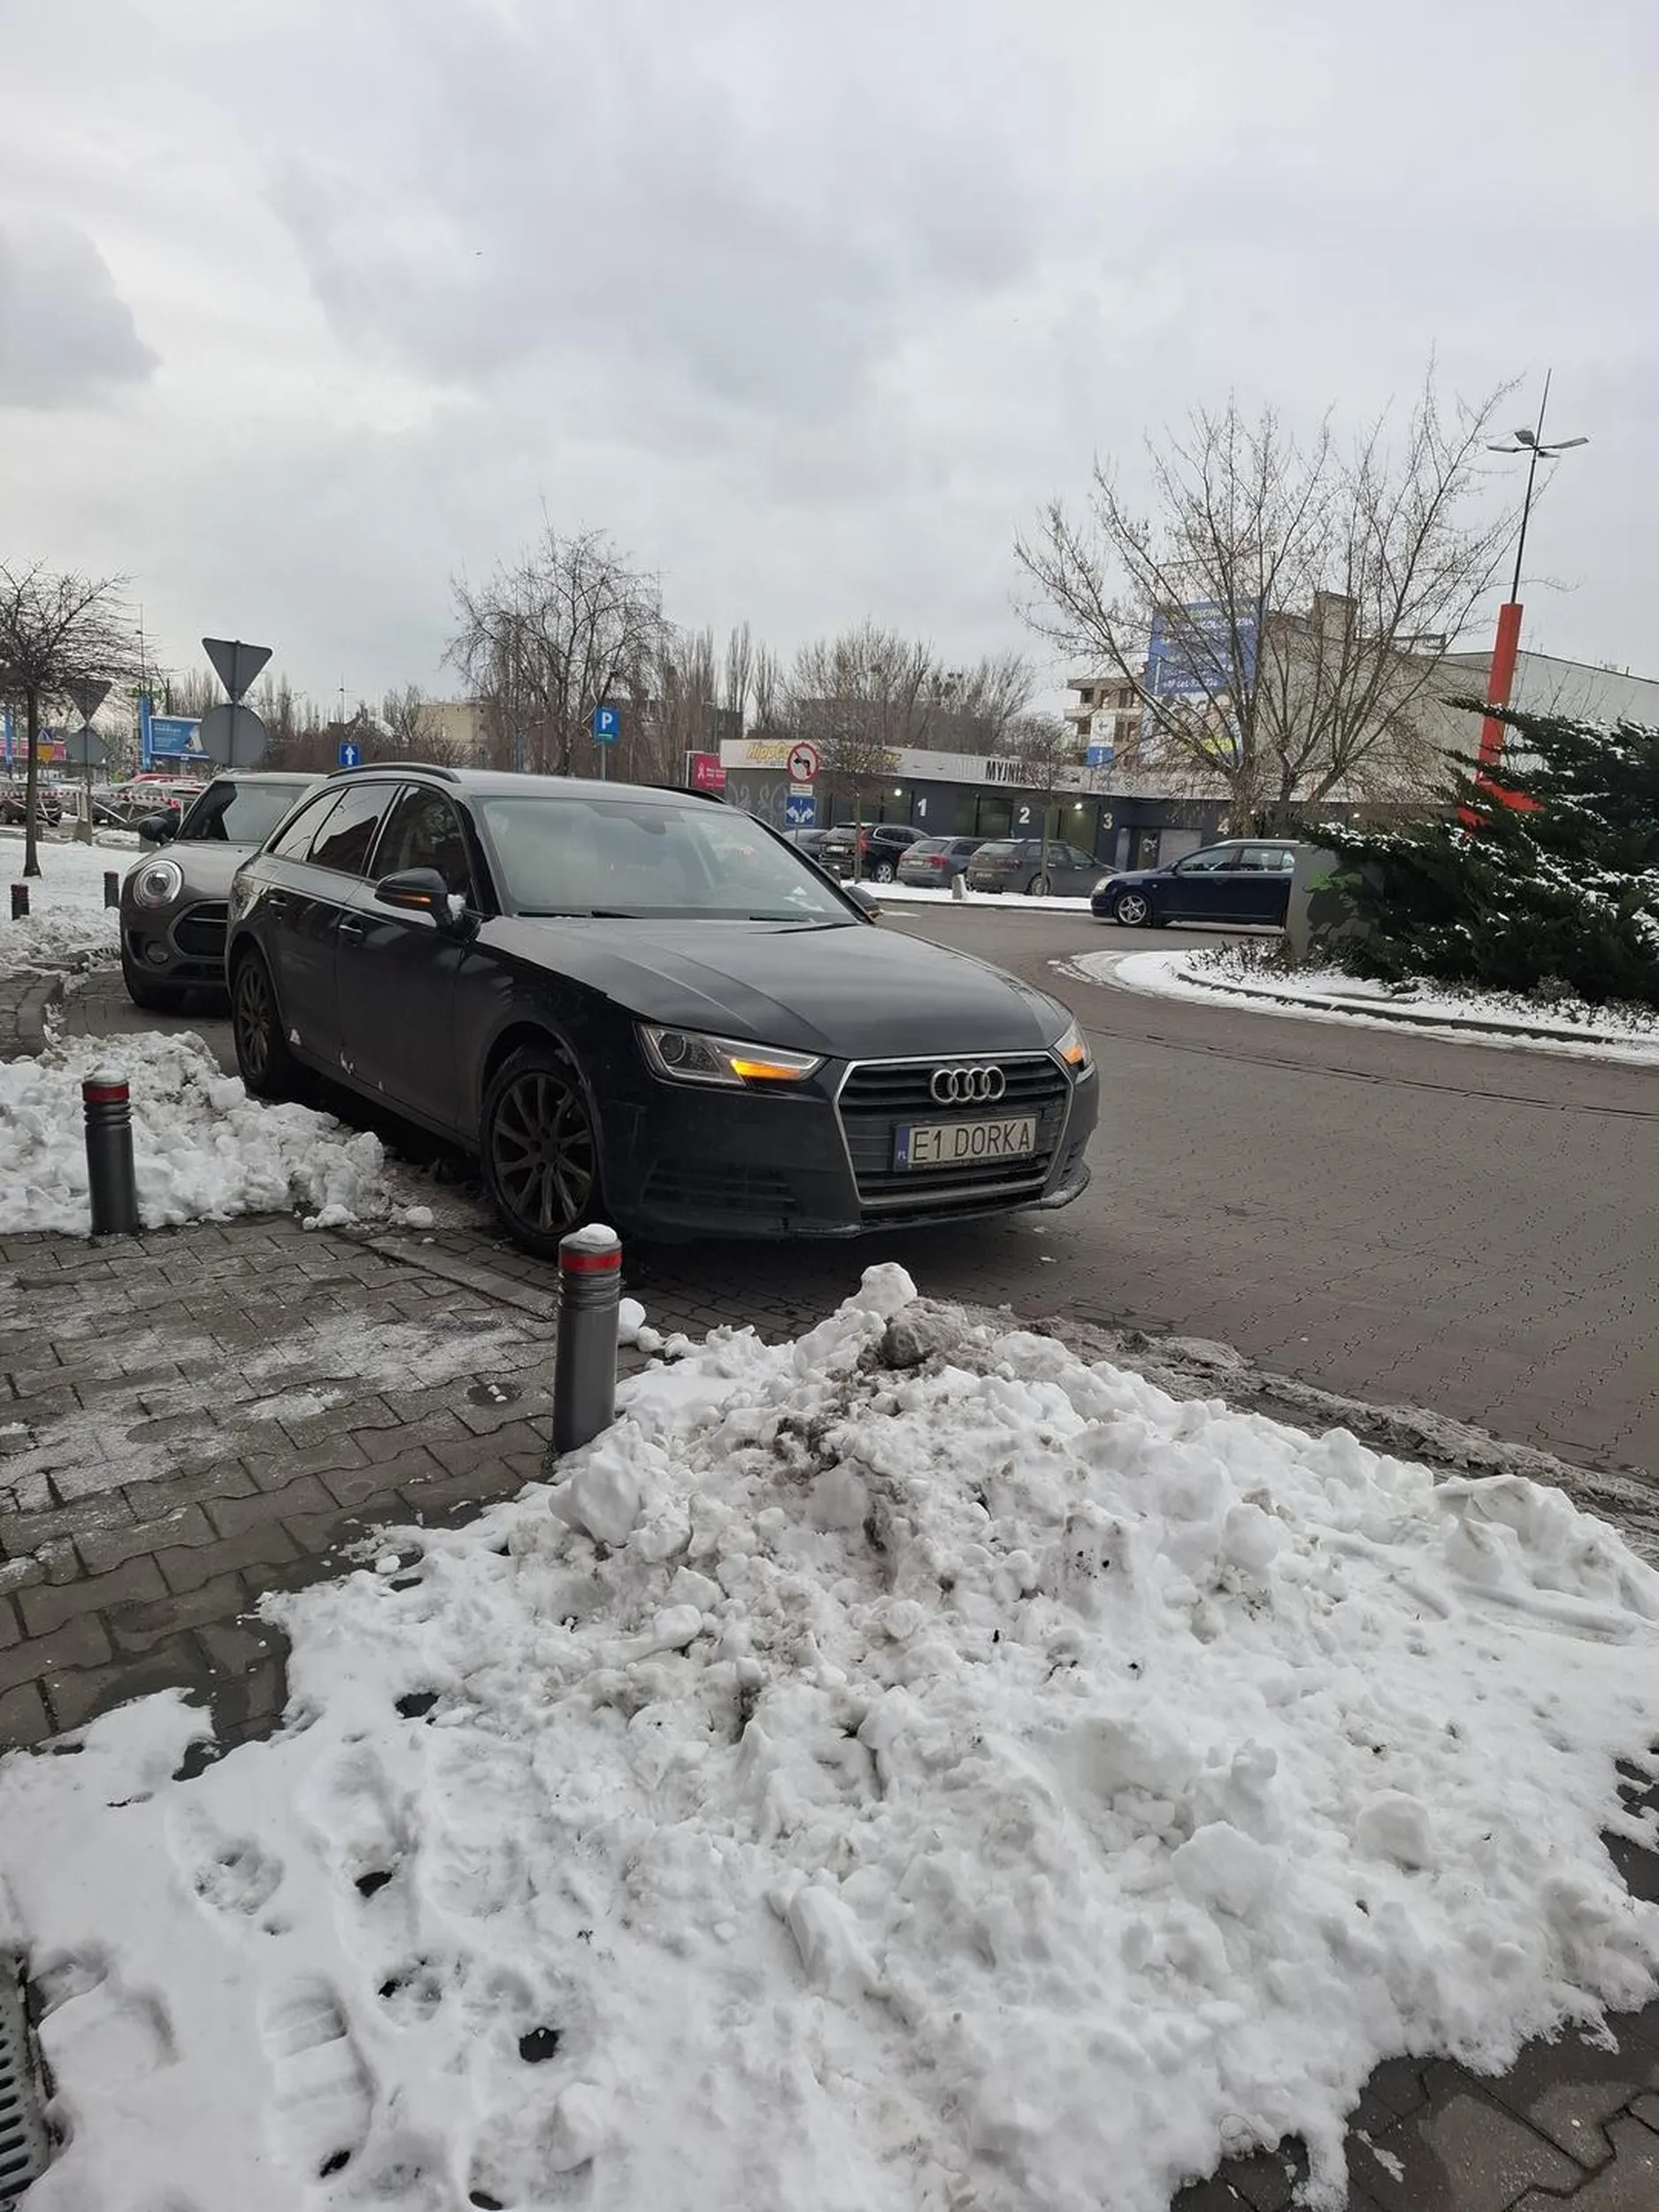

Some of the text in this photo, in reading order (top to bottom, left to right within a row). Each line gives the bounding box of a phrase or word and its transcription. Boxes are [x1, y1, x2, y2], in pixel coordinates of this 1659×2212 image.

[602, 711, 613, 730] P
[917, 798, 927, 817] 1
[1018, 806, 1031, 824] 2
[1102, 812, 1113, 830] 3
[912, 1122, 1030, 1161] E1 DORKA
